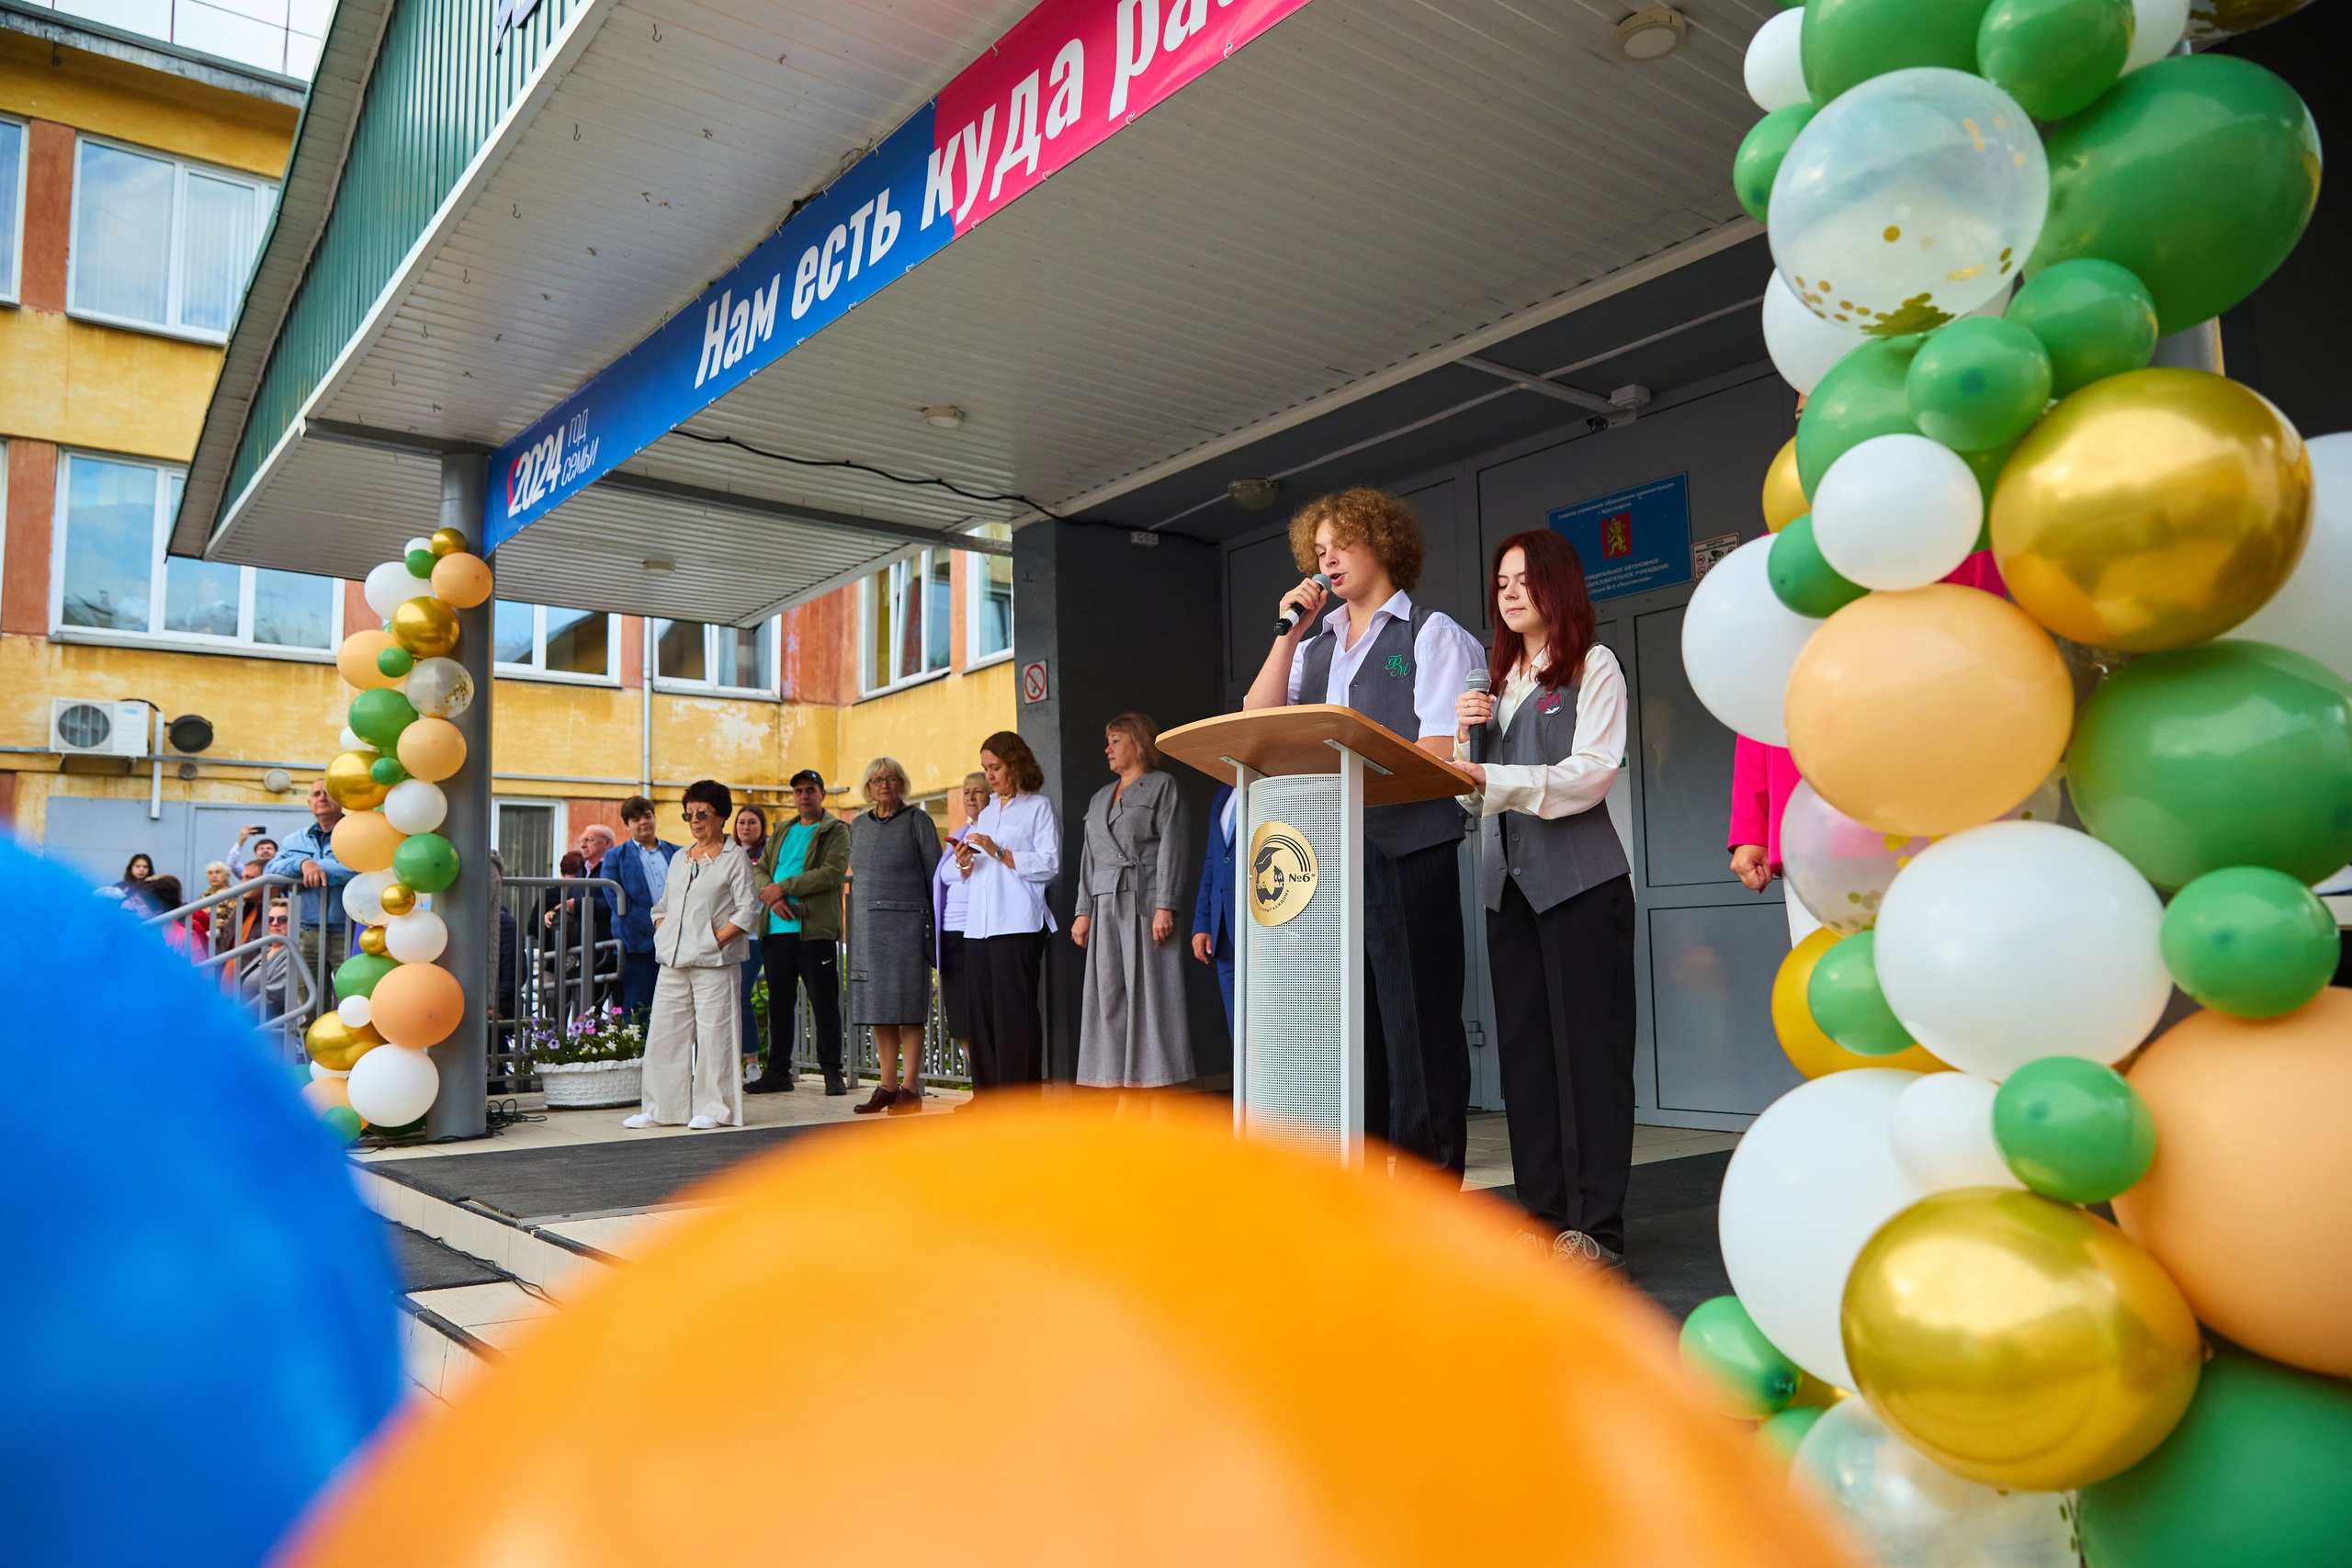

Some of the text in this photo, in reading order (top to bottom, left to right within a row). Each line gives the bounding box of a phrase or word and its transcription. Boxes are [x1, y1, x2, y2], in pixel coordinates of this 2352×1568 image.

[695, 0, 1237, 389] Нам есть куда ра
[507, 424, 565, 518] 2024
[1624, 558, 1658, 570] АВТОНОМНОЕ
[1634, 563, 1669, 577] УЧРЕЖДЕНИЕ
[1288, 873, 1310, 883] №6
